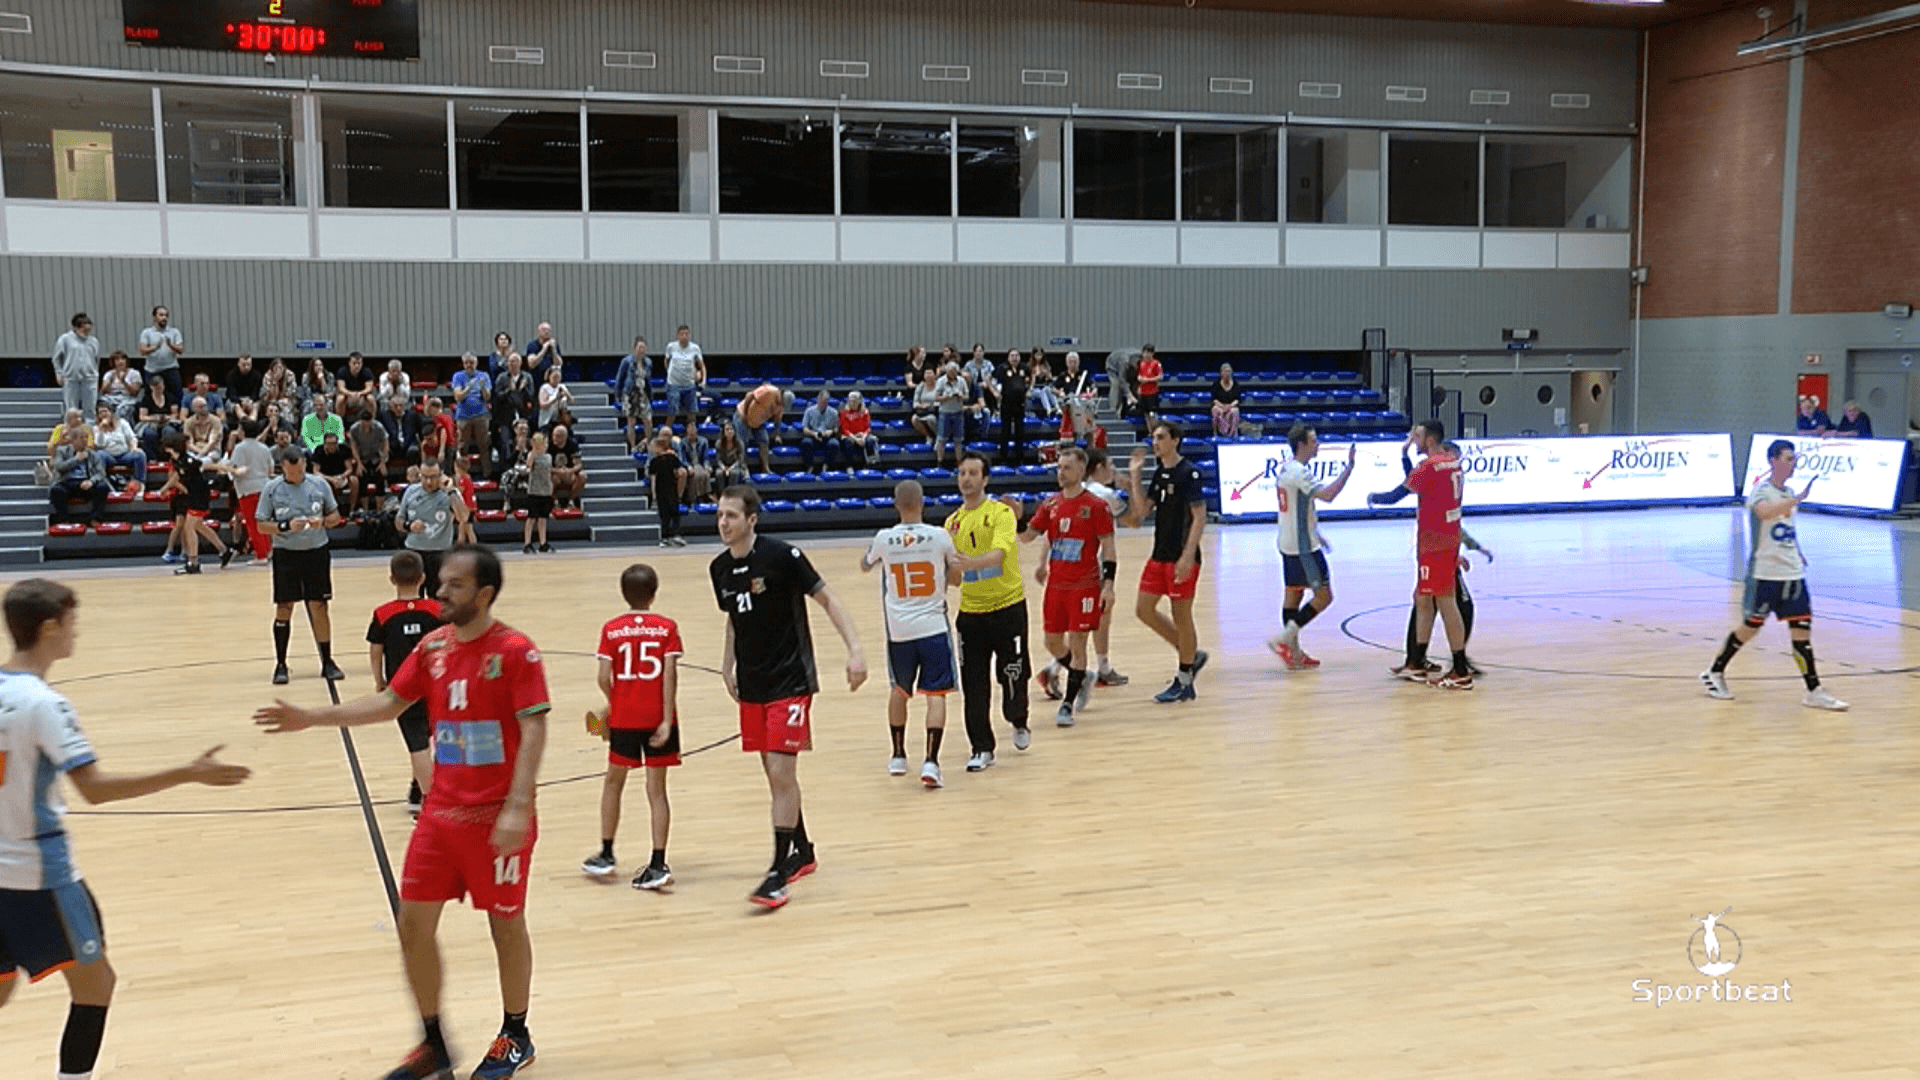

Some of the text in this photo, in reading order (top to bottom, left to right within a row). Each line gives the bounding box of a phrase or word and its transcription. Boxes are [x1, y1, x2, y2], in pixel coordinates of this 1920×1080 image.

[1461, 455, 1528, 476] OOIJEN
[1611, 449, 1690, 470] ROOIJEN
[1797, 453, 1859, 475] OOIJEN
[969, 531, 977, 550] 1
[889, 561, 935, 598] 13
[736, 591, 753, 613] 21
[1013, 635, 1021, 655] 1
[617, 641, 662, 680] 15
[448, 679, 468, 711] 14
[786, 703, 806, 728] 21
[493, 855, 521, 885] 14
